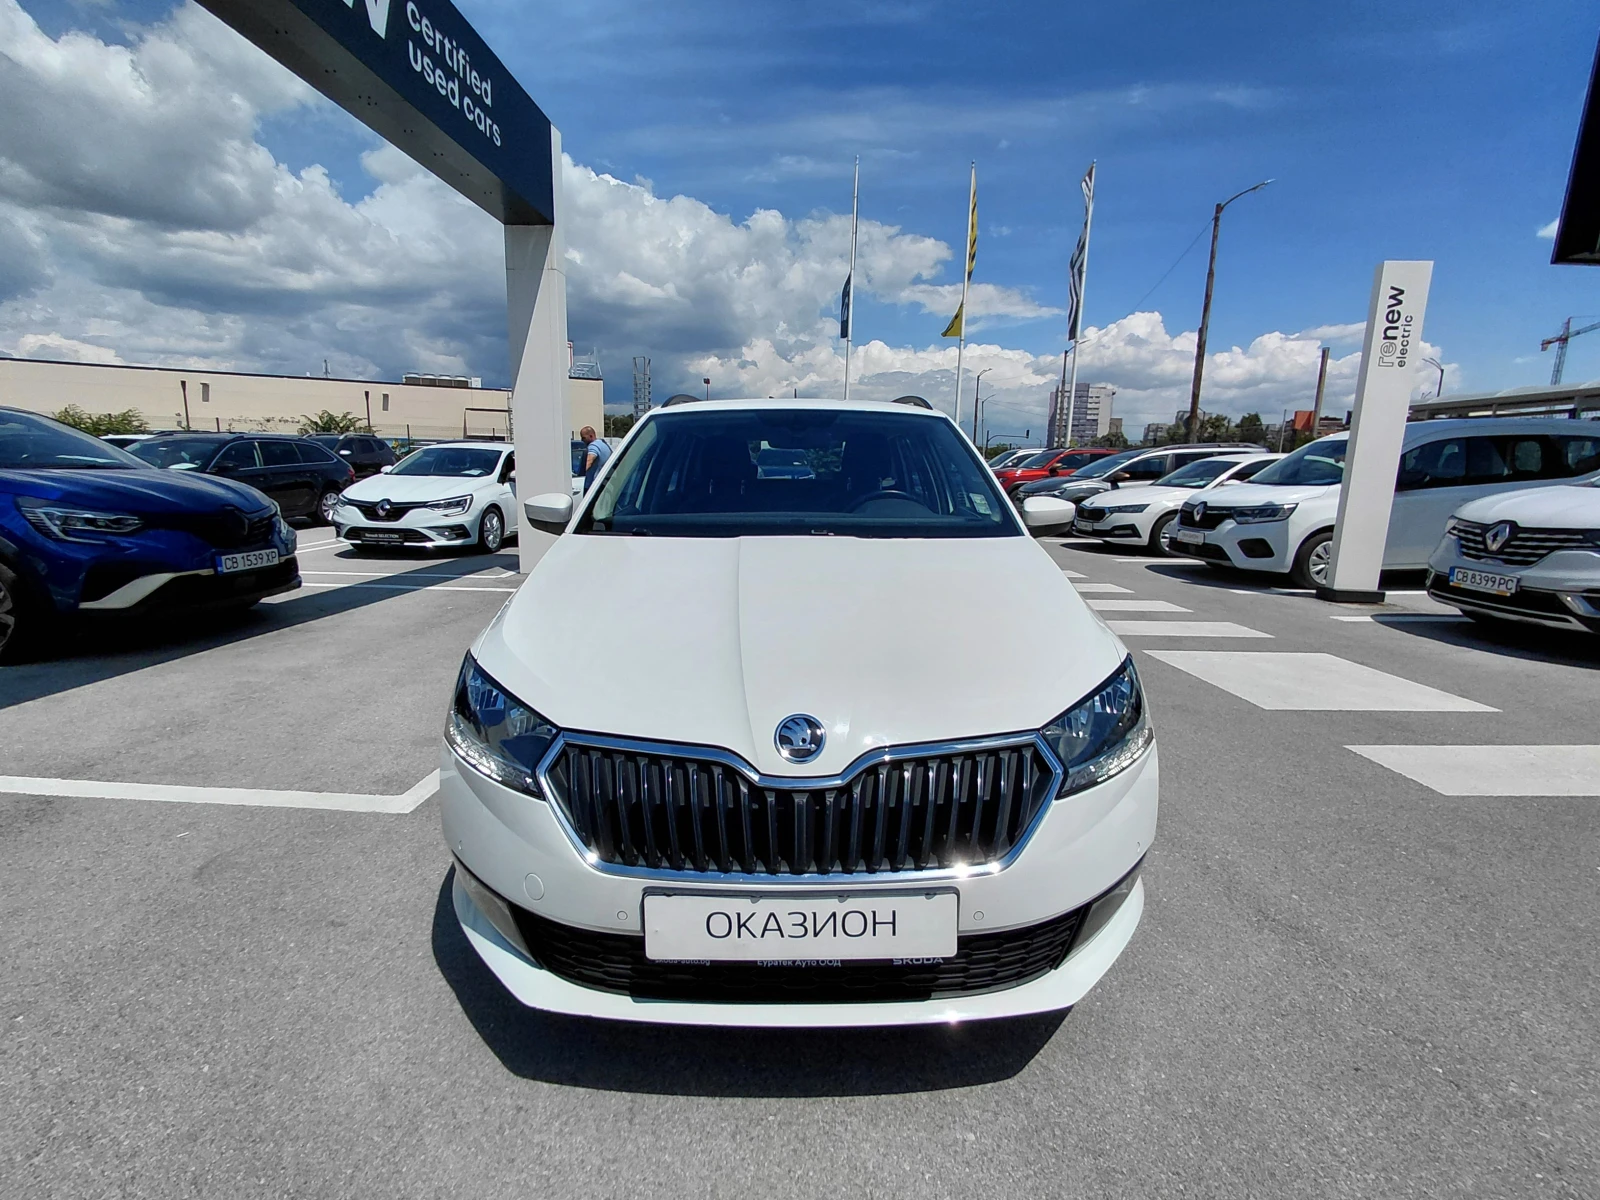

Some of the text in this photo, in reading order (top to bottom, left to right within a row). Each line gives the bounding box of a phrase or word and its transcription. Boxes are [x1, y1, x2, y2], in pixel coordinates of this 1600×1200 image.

[406, 1, 492, 108] certified
[408, 39, 502, 147] used cars
[1378, 286, 1405, 367] renew
[1396, 315, 1413, 367] electric
[241, 553, 264, 568] 1539
[1470, 573, 1497, 588] 8399
[705, 909, 897, 939] ОКАЗИОН
